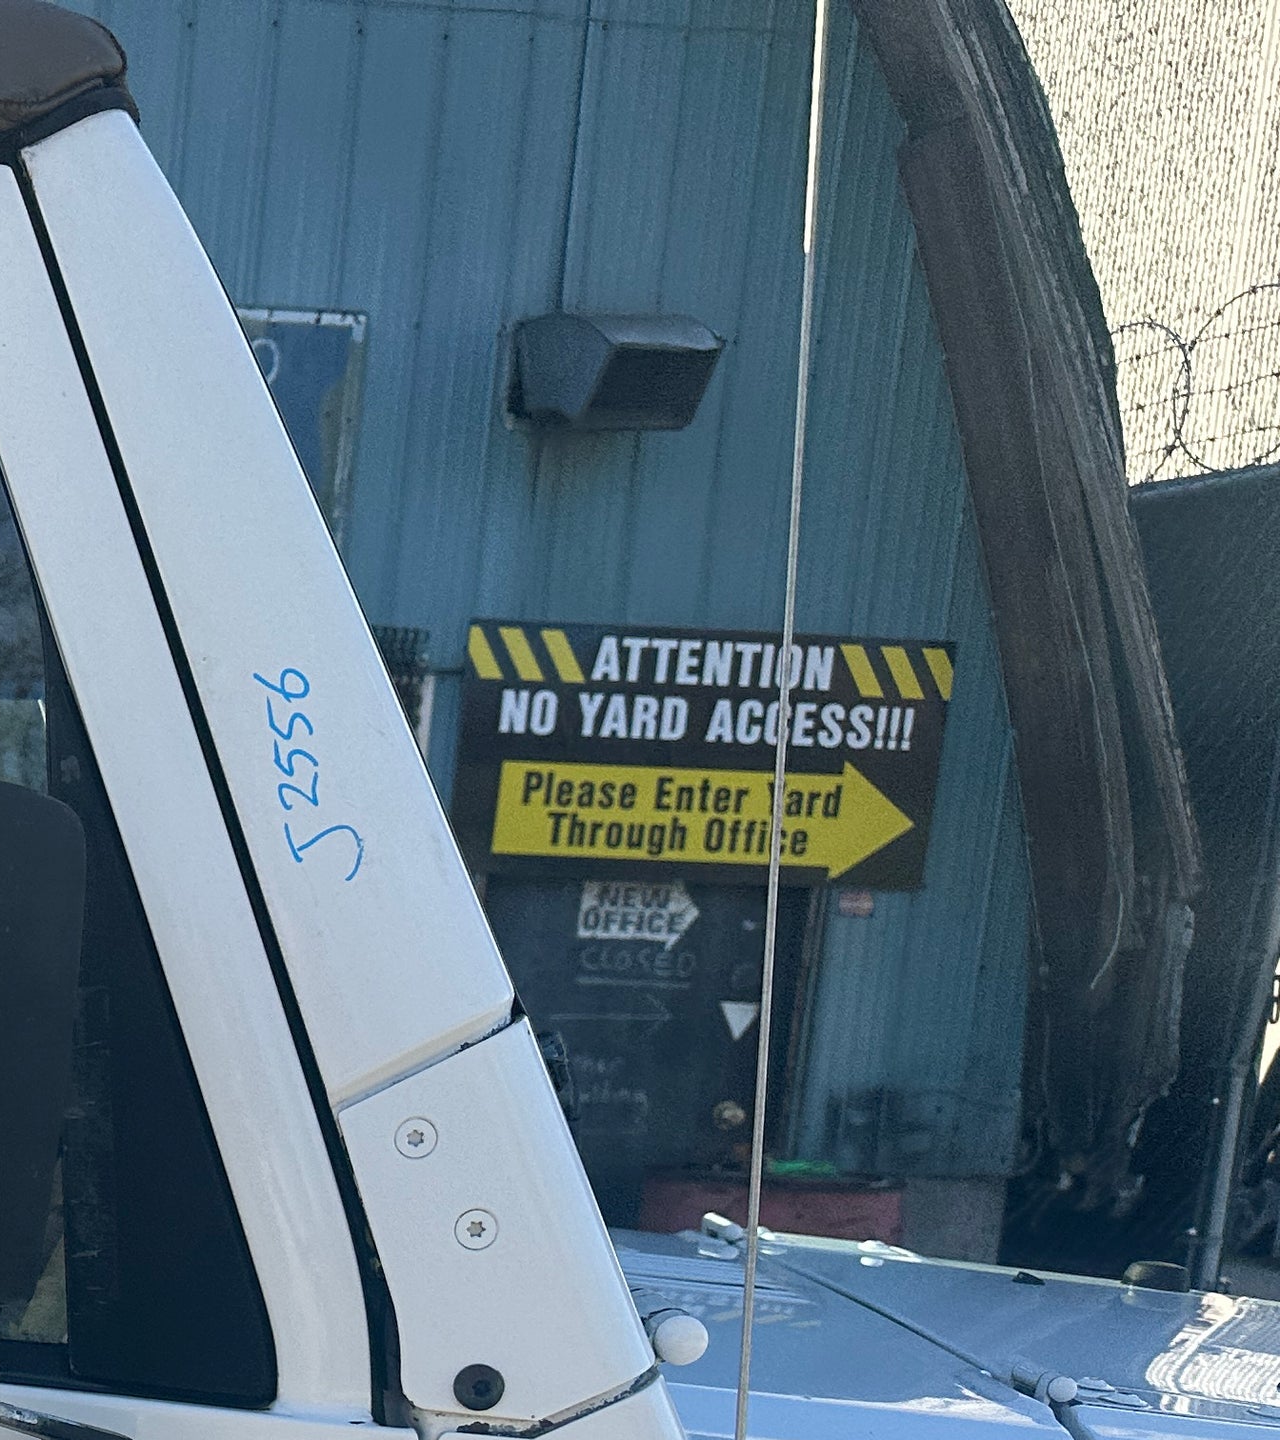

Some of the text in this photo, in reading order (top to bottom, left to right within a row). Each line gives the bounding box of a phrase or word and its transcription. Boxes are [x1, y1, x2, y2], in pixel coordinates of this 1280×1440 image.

[590, 635, 835, 691] ATTENTION
[497, 689, 916, 751] NO YARD ACCESS!!!
[252, 667, 365, 882] J2556
[521, 771, 636, 810] Please
[653, 776, 750, 814] Enter
[546, 812, 688, 857] Through
[597, 884, 671, 908] NEW
[582, 906, 686, 935] OFFICE
